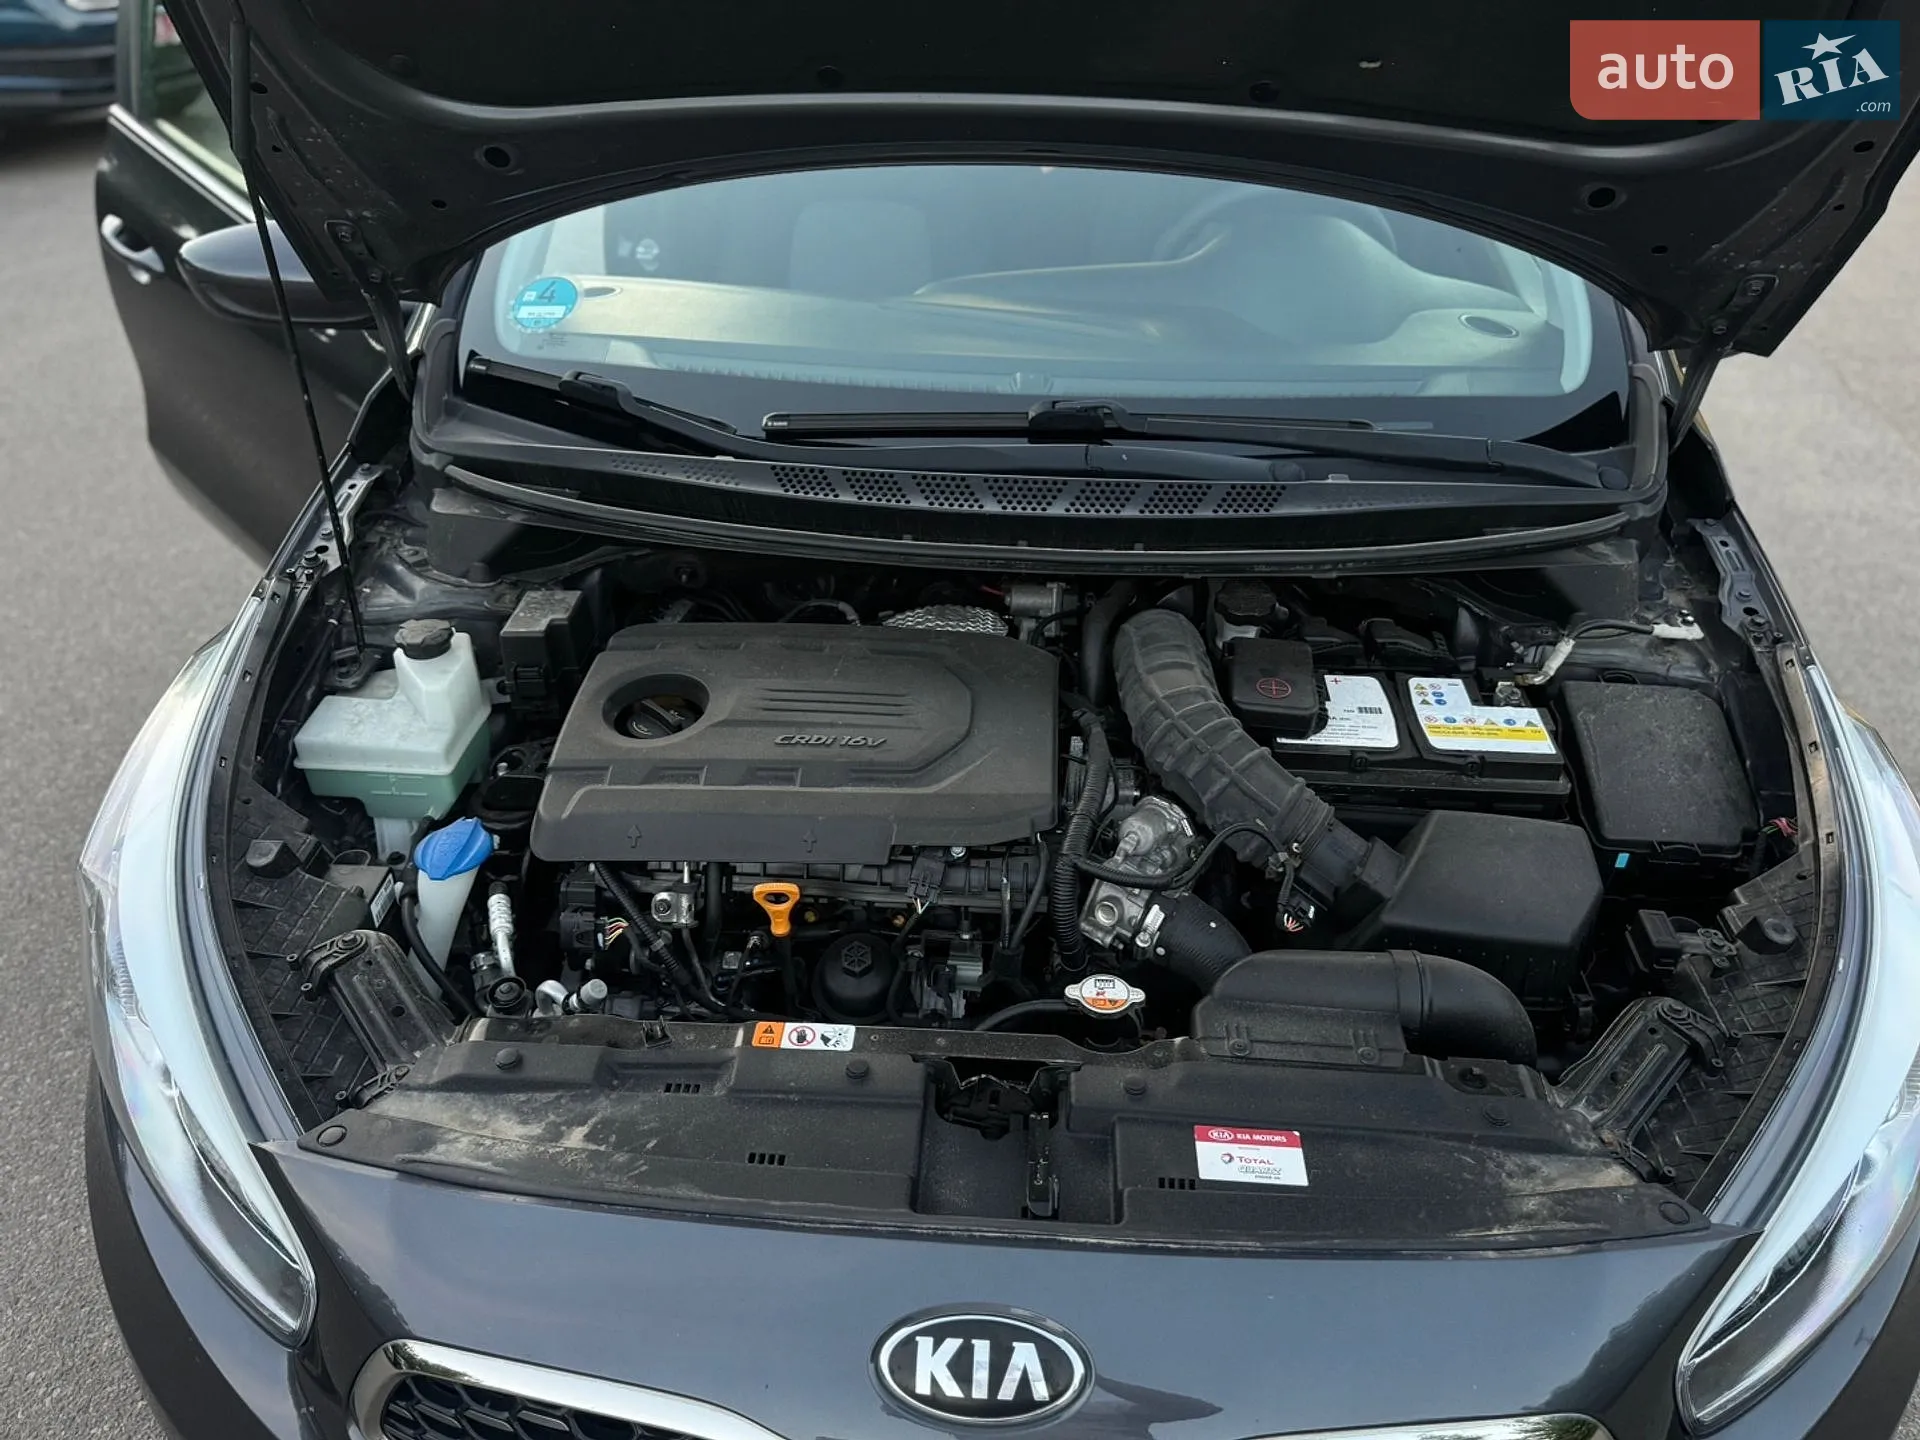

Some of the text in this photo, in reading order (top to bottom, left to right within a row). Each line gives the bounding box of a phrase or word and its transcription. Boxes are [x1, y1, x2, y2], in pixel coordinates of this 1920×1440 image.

[539, 280, 556, 303] 4
[840, 735, 888, 748] 16V
[1236, 1133, 1251, 1141] KIA
[1252, 1134, 1288, 1143] MOTORS
[1236, 1156, 1275, 1166] TOTAL
[914, 1335, 1051, 1402] KIA
